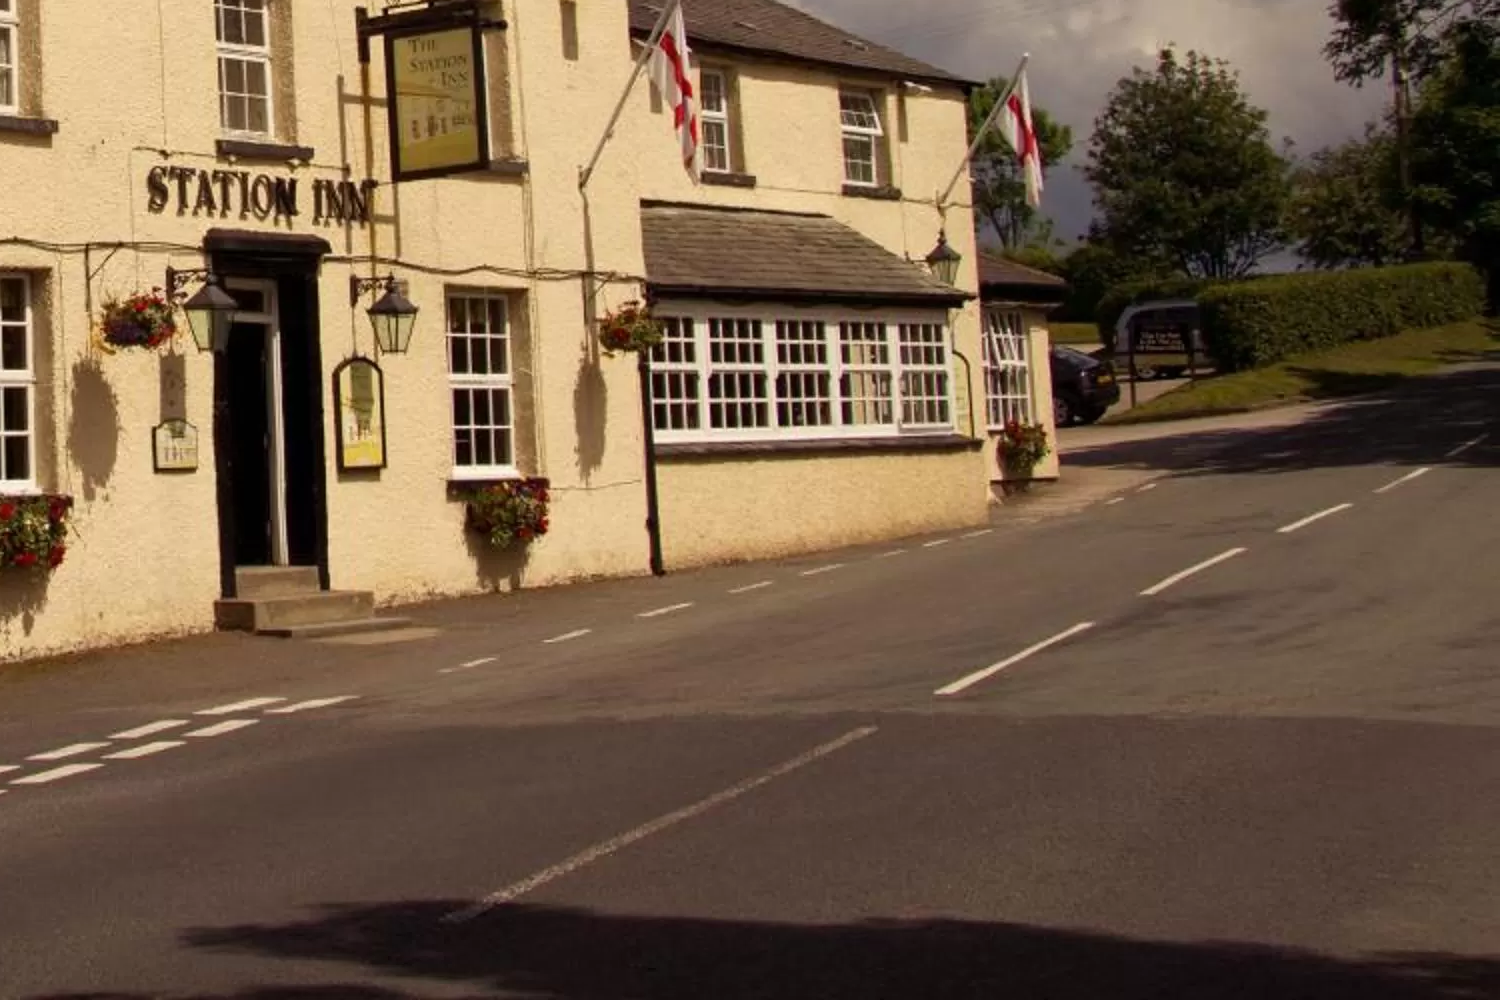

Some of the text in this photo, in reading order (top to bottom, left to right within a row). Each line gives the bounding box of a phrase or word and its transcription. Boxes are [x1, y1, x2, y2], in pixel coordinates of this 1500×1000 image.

[408, 54, 468, 73] STATION
[147, 165, 372, 225] STATION INN
